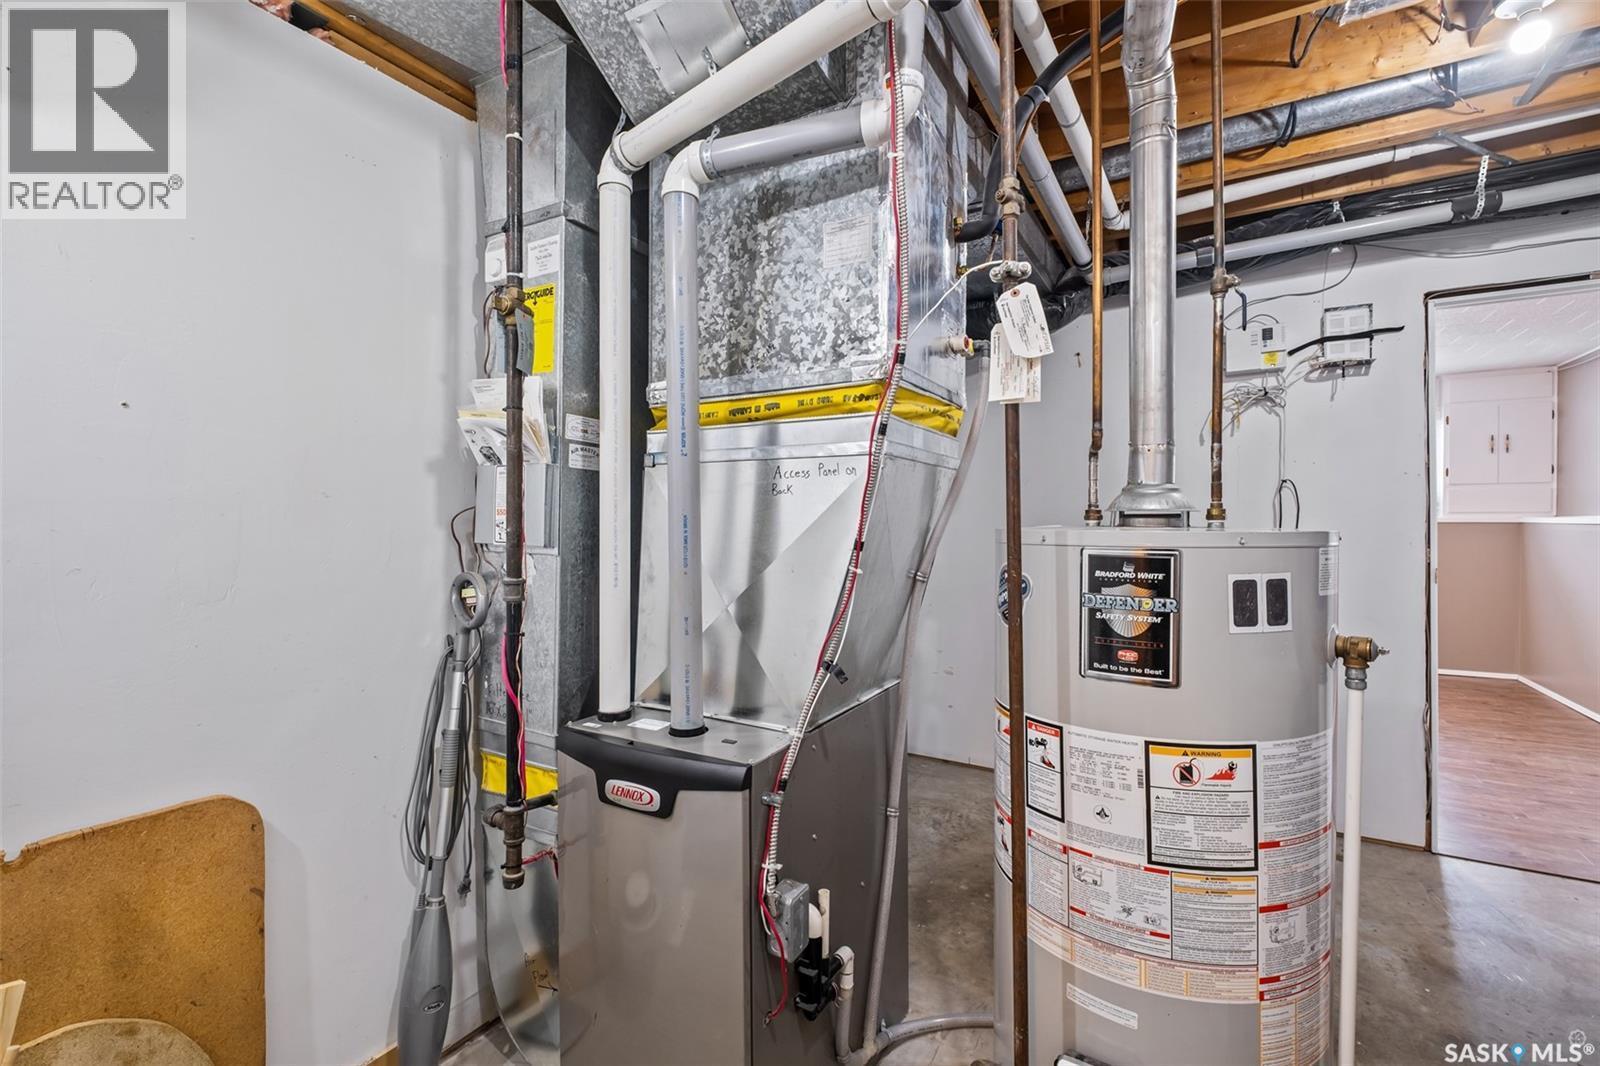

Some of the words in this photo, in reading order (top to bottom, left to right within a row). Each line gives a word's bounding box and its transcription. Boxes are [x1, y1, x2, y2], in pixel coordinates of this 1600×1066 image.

[773, 465, 810, 480] Access
[818, 462, 840, 477] Panel
[845, 466, 857, 476] on
[771, 482, 794, 497] Back
[1094, 570, 1136, 579] BRADFORD
[1082, 593, 1178, 613] DEFENDER
[1095, 611, 1124, 621] SAFETY
[611, 785, 645, 802] LENNOX
